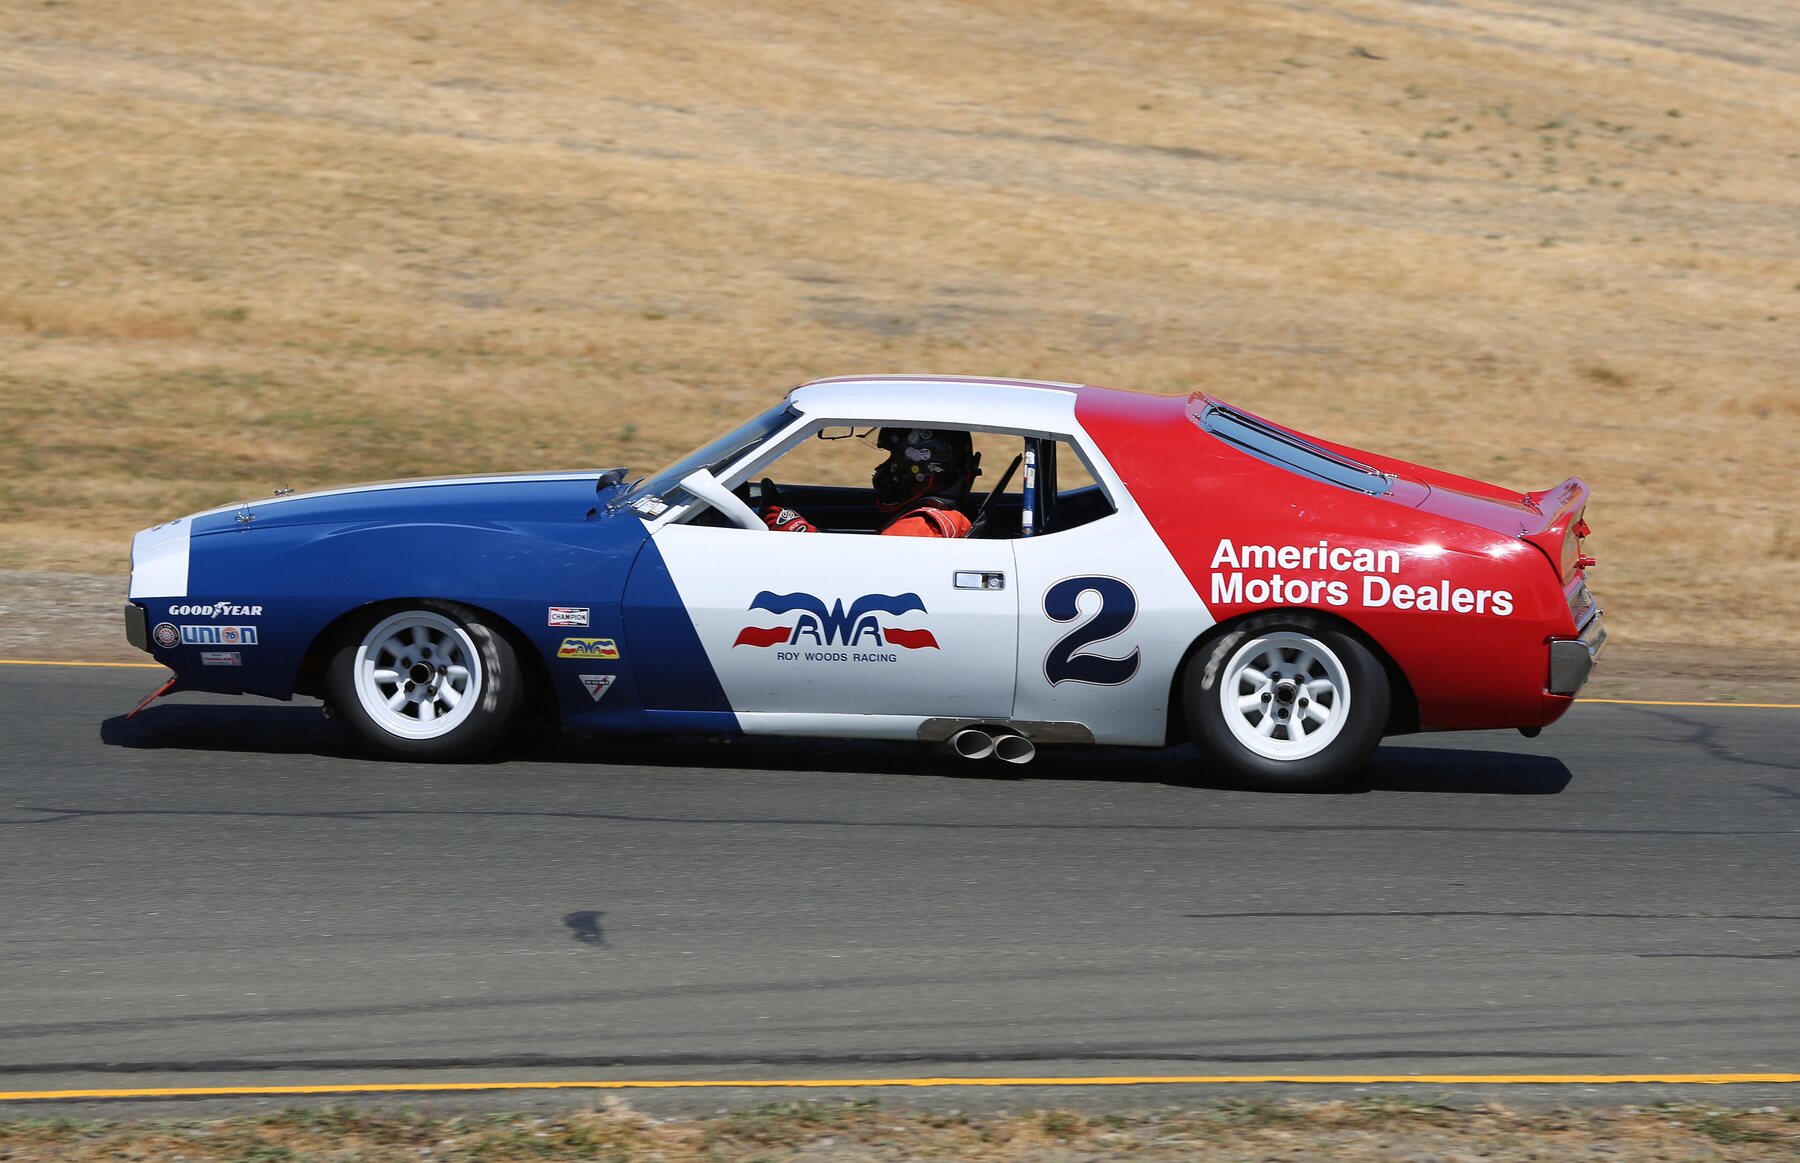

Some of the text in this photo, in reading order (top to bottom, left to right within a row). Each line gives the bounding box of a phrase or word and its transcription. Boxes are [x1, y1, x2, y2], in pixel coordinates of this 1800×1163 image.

[1210, 538, 1400, 573] American
[1211, 572, 1514, 616] Motors Dealers
[552, 613, 586, 621] CHAMPION
[224, 631, 236, 640] 76
[1042, 573, 1141, 688] 2
[777, 652, 897, 663] ROY WOODS RACING
